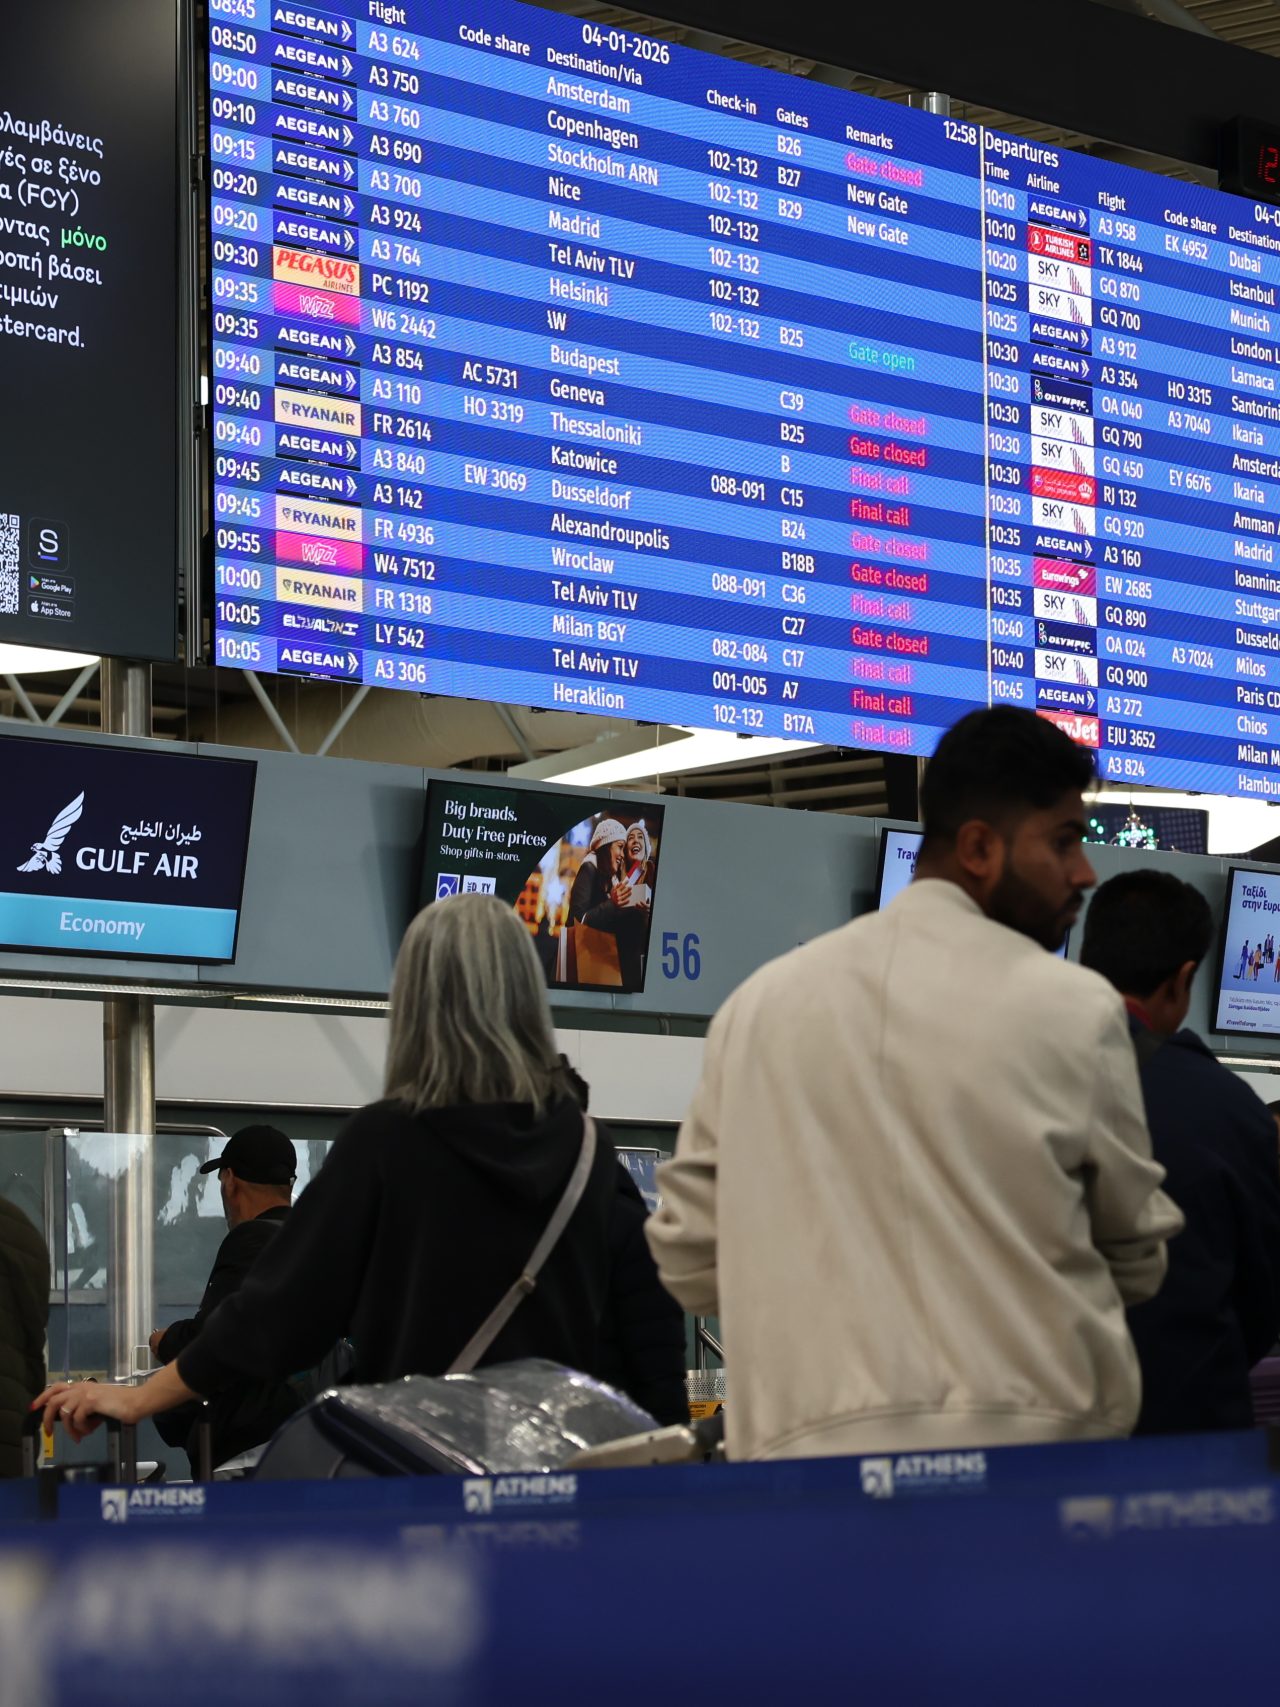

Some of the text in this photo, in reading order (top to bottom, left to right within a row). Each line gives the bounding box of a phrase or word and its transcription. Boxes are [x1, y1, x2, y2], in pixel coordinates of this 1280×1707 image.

[369, 1, 406, 24] Flight
[212, 26, 256, 54] 08:50
[460, 25, 530, 56] Code share
[583, 24, 670, 64] 04-01-2026
[275, 45, 338, 70] AEGEAN
[548, 48, 642, 85] Destination/Via
[369, 66, 418, 94] A3 750
[707, 90, 756, 115] Check-in
[548, 110, 638, 149] Copenhagen
[777, 108, 808, 128] Gates
[847, 126, 893, 149] Remarks
[944, 121, 976, 145] 12:58
[985, 132, 1058, 167] Departures
[32, 158, 100, 185] σε ξένο
[708, 150, 758, 178] 102-132
[984, 162, 1010, 181] Time
[778, 167, 800, 187] B27
[1027, 174, 1060, 193] Airline
[18, 179, 78, 216] (FCY)
[848, 184, 908, 214] New Gate
[62, 226, 106, 250] μόνο
[986, 219, 1015, 240] 10:10
[1044, 234, 1075, 249] TURKISH
[1044, 244, 1075, 259] AIRLINES
[1099, 247, 1143, 272] TK 1844
[49, 255, 102, 285] βάσει
[276, 250, 356, 283] PEGASUS
[1038, 261, 1060, 277] SKY
[323, 279, 354, 293] AIRLINES
[373, 274, 428, 303] PC 1192
[1100, 277, 1139, 301] GQ 870
[1230, 280, 1275, 305] Istanbul
[1231, 309, 1270, 332] Munich
[291, 403, 356, 427] RYANAIR
[374, 414, 431, 441] FR 2614
[552, 446, 617, 474] Katowice
[712, 475, 764, 500] 088-091
[781, 488, 803, 507] C15
[851, 500, 910, 527] Final call
[40, 530, 58, 553] S
[551, 514, 670, 550] Alexandroupolis
[42, 582, 72, 594] Google Play
[41, 606, 71, 617] App Store
[554, 683, 624, 709] Heraklion
[784, 714, 814, 734] B17A
[445, 800, 517, 821] Big brands.
[120, 821, 201, 846] طيران الخليج
[443, 823, 546, 847] Duty Free prices
[76, 847, 198, 879] GULF AIR
[440, 845, 520, 862] Shop gifts in-store.
[1243, 886, 1266, 899] Ταξίδι
[1242, 900, 1262, 912] στην
[60, 912, 145, 940] Economy
[662, 932, 700, 980] 56
[894, 1453, 988, 1476] ATHENS
[128, 1488, 206, 1508] ATHENS
[492, 1476, 578, 1498] ATHENS
[1122, 1488, 1276, 1528] ATHENS
